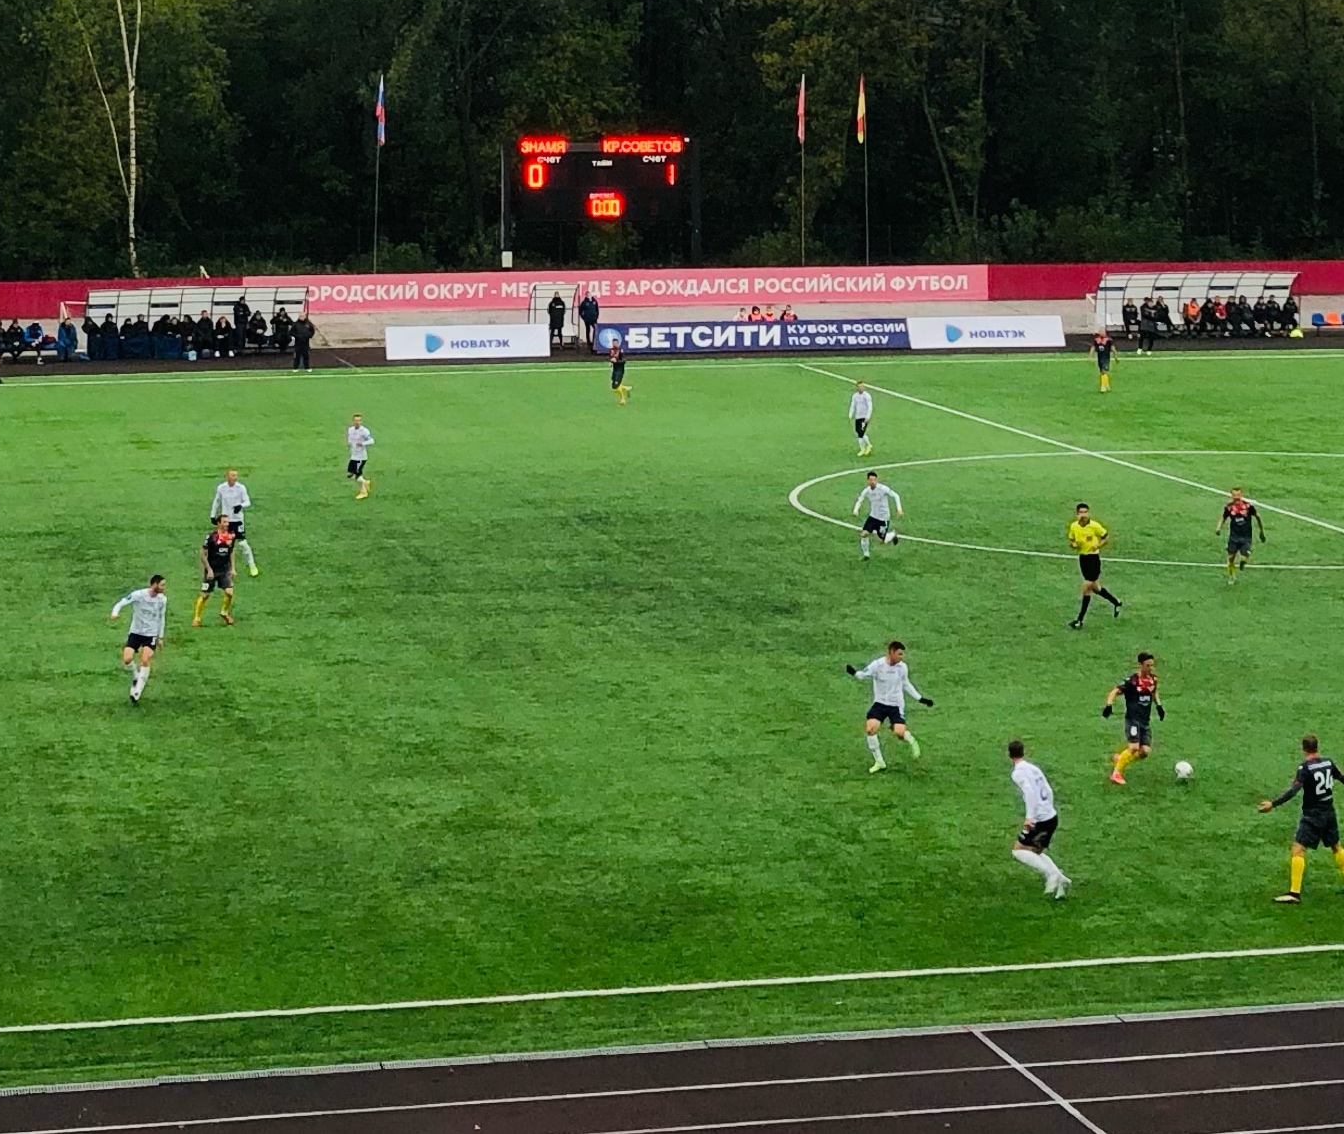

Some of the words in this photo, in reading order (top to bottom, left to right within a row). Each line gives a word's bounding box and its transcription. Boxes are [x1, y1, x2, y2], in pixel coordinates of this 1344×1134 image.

[520, 139, 567, 154] ЗНАМЯ
[528, 164, 544, 188] 0
[306, 281, 419, 303] ОРОДСКИЙ
[422, 282, 489, 300] ОКРУГ
[615, 278, 749, 298] ЗАРОЖДАЛСЯ
[754, 273, 887, 294] РОССИЙСКИЙ
[889, 274, 968, 292] ФУТБОЛ
[787, 324, 838, 334] КУБОК
[842, 322, 906, 333] РОССИИ
[969, 329, 1026, 339] НОВАТЭК
[450, 339, 510, 349] НОВАТЭК
[625, 324, 782, 349] БЕТСИТИ
[788, 336, 810, 346] ПО
[814, 335, 889, 346] ФУТБОЛУ
[1313, 768, 1334, 795] 24
